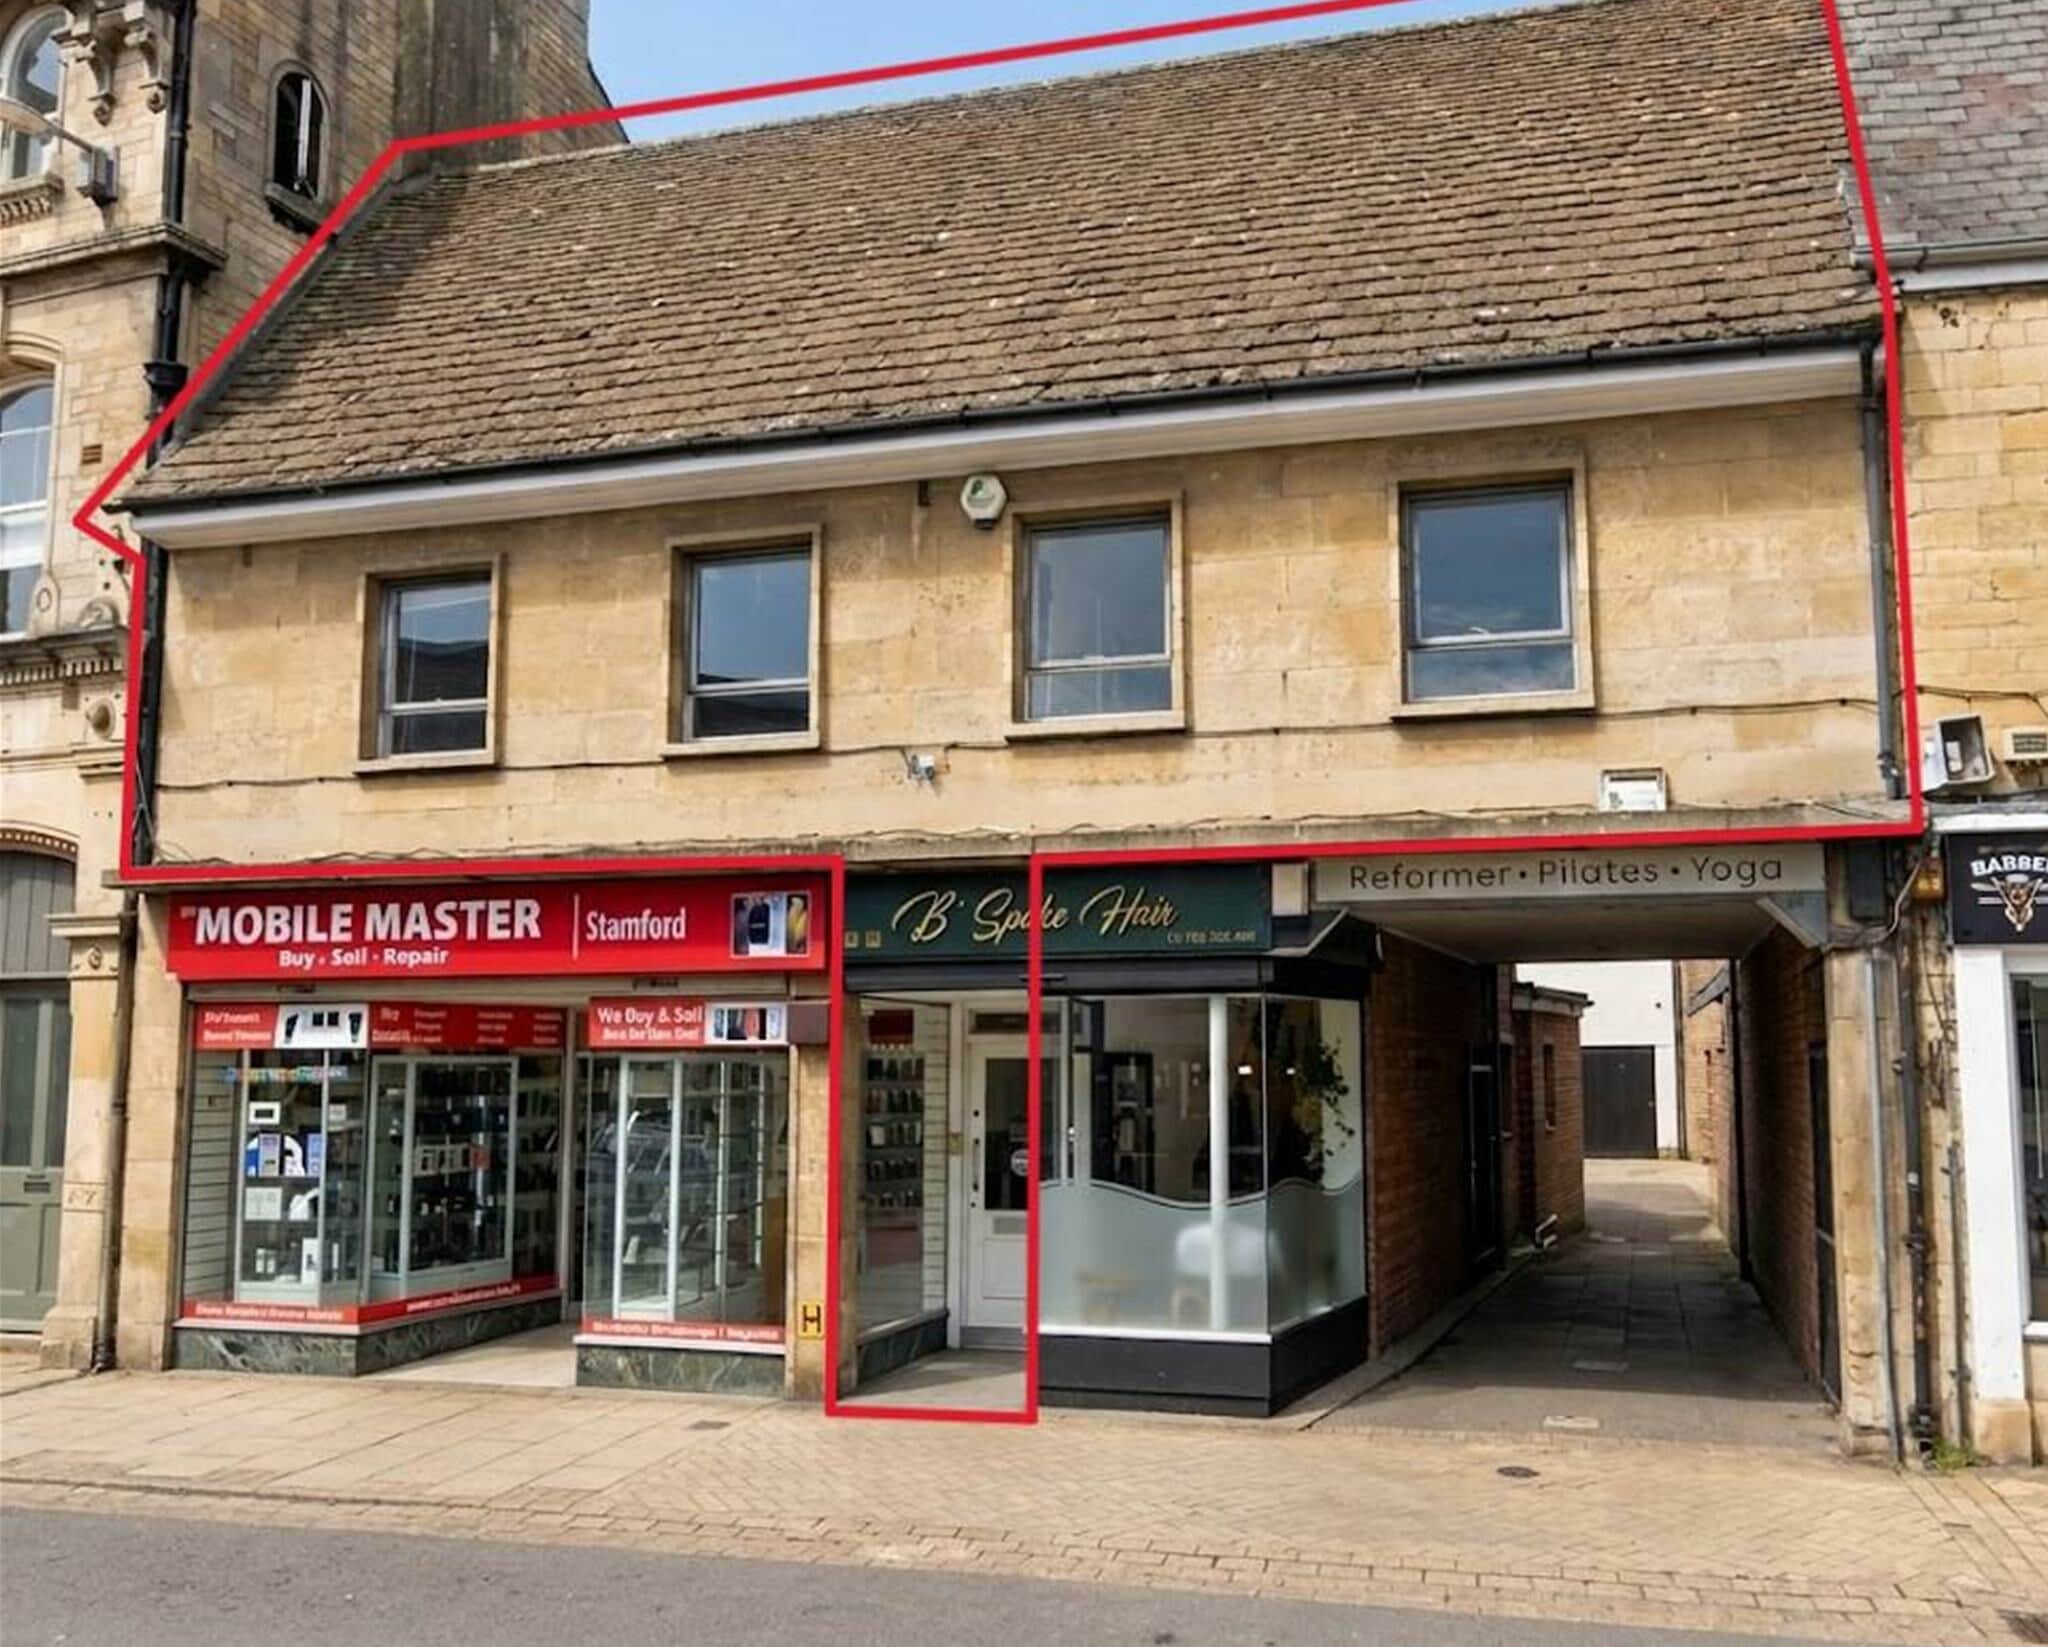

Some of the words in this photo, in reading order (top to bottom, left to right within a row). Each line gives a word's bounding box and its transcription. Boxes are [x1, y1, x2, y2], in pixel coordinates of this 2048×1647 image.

[1350, 863, 1512, 890] Reformer
[1538, 855, 1660, 885] Pilates
[1691, 855, 1783, 888] Yoga
[1970, 854, 2048, 877] BARBE
[195, 904, 353, 945] MOBILE
[364, 898, 542, 941] MASTER
[586, 907, 687, 941] Stamford
[1079, 884, 1177, 936] Hair
[279, 950, 315, 970] Buy
[383, 946, 448, 968] Repair
[598, 1008, 622, 1024] We
[802, 1306, 821, 1333] H
